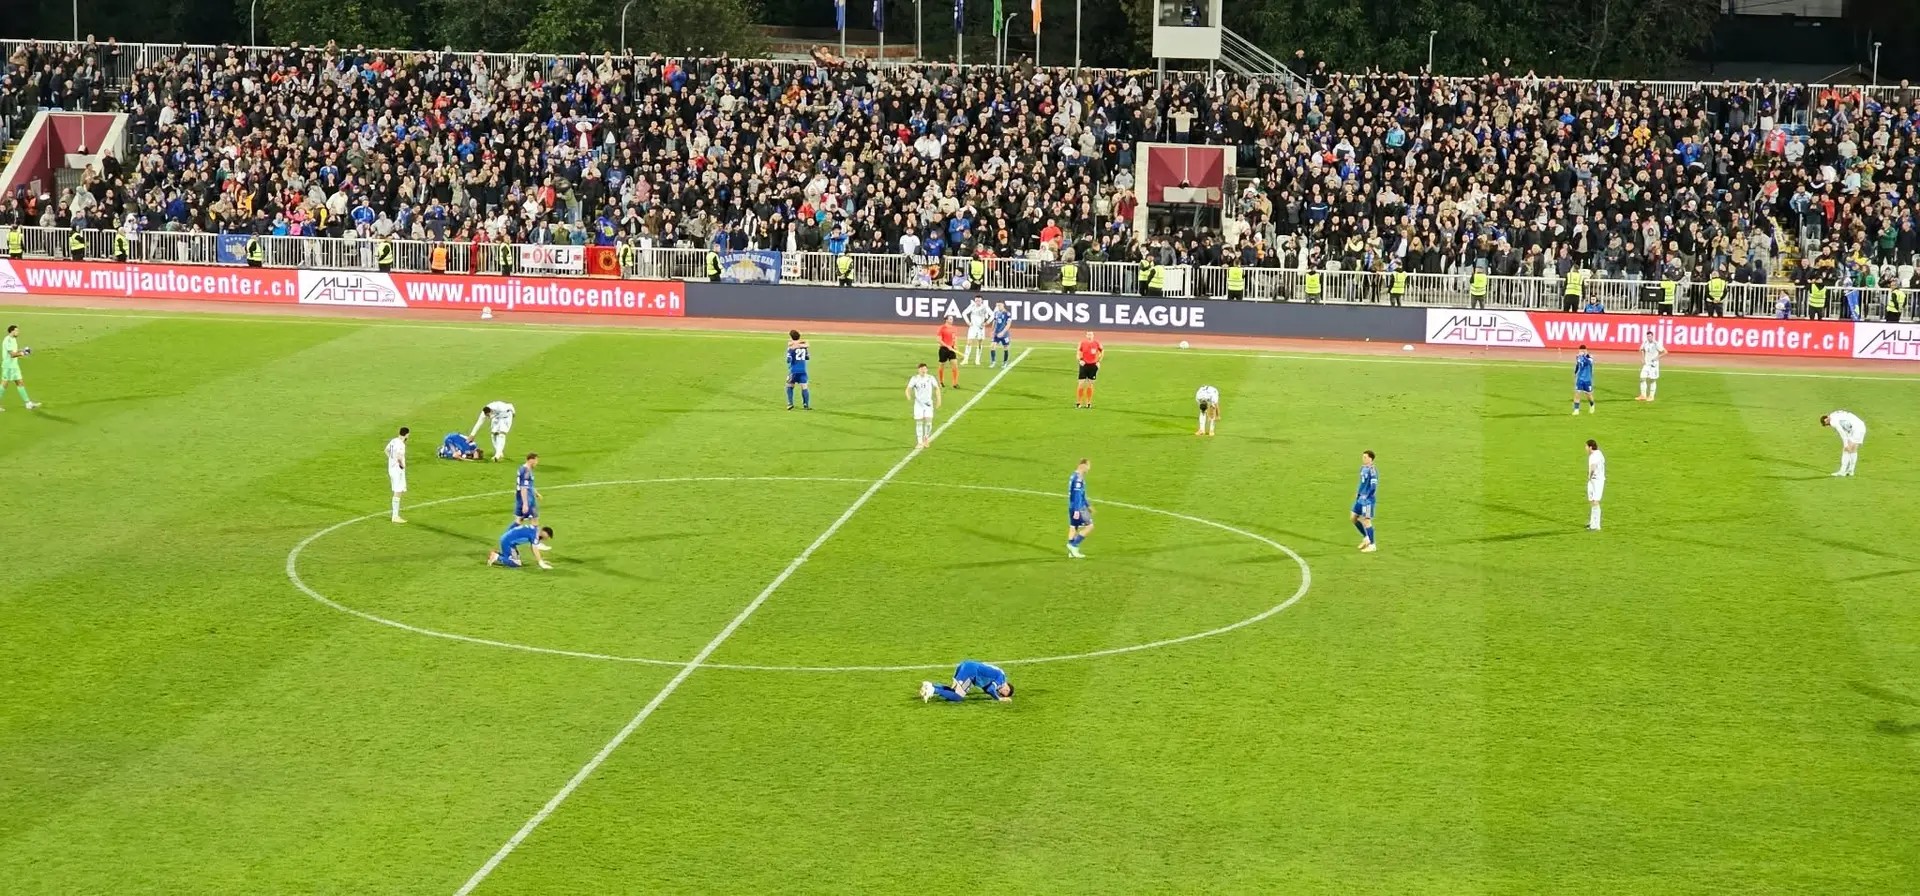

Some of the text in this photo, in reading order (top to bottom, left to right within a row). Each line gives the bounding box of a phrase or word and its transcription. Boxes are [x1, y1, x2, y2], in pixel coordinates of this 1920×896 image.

[25, 267, 295, 297] www.mujiautocenter.ch
[304, 277, 362, 299] MUJI
[314, 288, 378, 302] AUTO
[405, 279, 680, 310] www.mujiautocenter.ch
[895, 296, 1205, 327] UEFA TIONS LEAGUE
[1432, 315, 1497, 339] MUJI
[1443, 327, 1514, 342] AUTO
